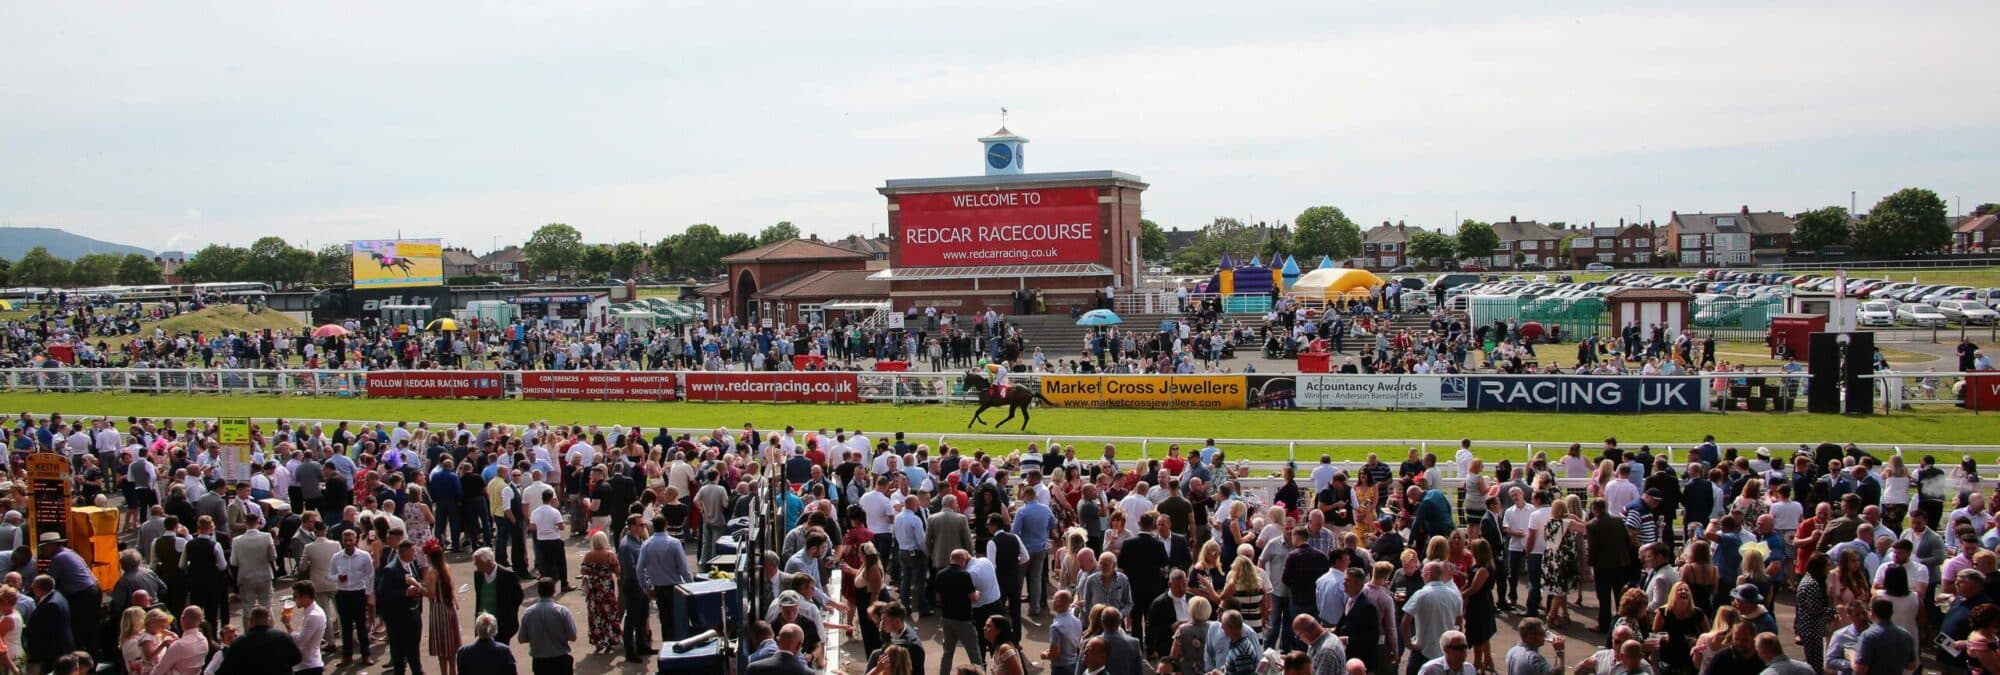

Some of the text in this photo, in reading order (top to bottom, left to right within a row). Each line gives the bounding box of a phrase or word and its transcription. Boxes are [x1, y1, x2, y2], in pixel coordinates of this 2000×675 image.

[953, 192, 1040, 207] WELCOME TO
[906, 223, 1092, 244] REDCAR RACECOURSE
[943, 247, 1057, 259] www.redcarracing.co.uk
[370, 379, 469, 388] FOLLOW REDCAR RACING
[691, 379, 852, 395] www.redcarracing.co.uk
[1046, 380, 1239, 394] Market Cross Jewellers
[1306, 382, 1417, 393] Accountancy Awards
[1480, 381, 1688, 406] RACING UK
[1064, 398, 1221, 409] www.marketcrossjewellers.com
